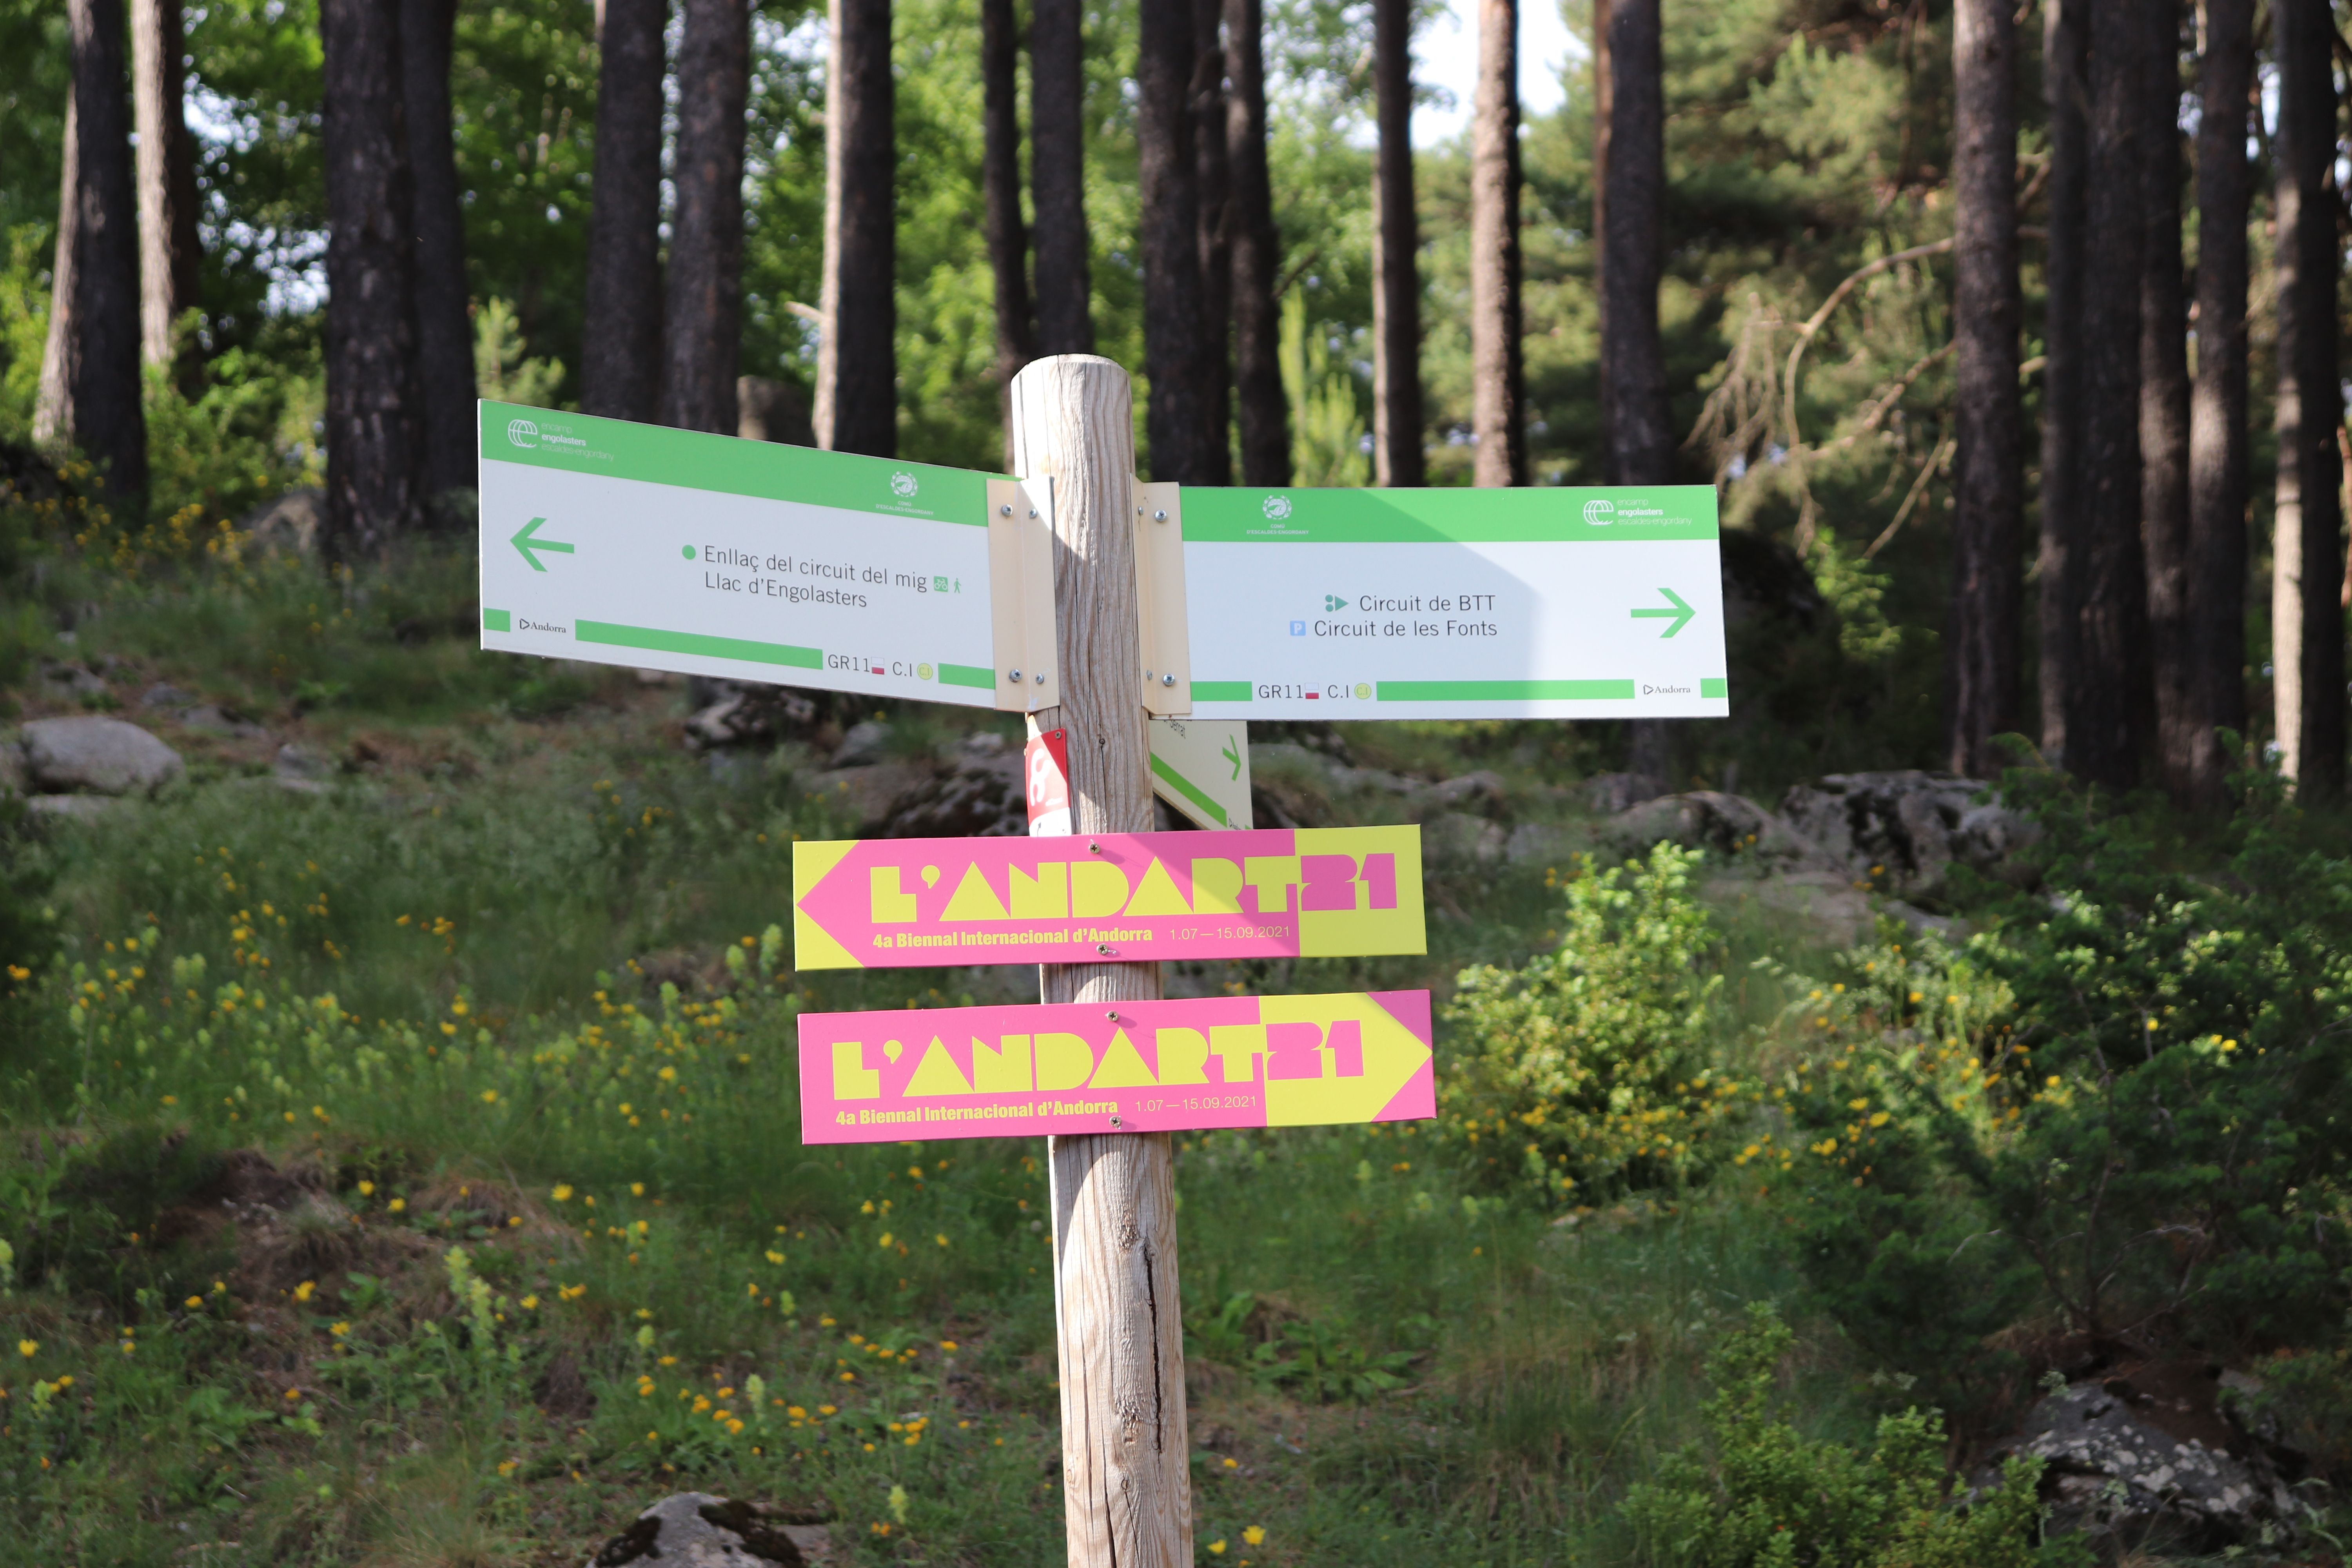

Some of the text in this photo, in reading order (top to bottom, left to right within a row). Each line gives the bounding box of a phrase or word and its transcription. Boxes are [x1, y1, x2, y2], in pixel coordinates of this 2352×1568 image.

[541, 422, 572, 433] encamp
[541, 434, 586, 446] engolasters
[541, 444, 614, 461] escaldes-engordany
[1617, 499, 1648, 508] encamp
[1618, 508, 1663, 517] engolasters
[1618, 517, 1692, 525] escaldes-engordany
[705, 545, 927, 593] Enllaç del circuit del mig
[706, 571, 741, 592] Llac
[1360, 595, 1496, 611] Circuit de BTT
[531, 622, 566, 633] Andorra
[1314, 620, 1497, 636] Circuit de les Fonts
[828, 654, 912, 677] GR11 C.I
[1258, 685, 1349, 698] GR11 C.I
[1655, 685, 1691, 693] Andorra
[873, 933, 892, 948] 4a
[897, 931, 957, 947] Biennal
[961, 927, 1069, 946] Internacional
[836, 1111, 855, 1125] 4a
[860, 1107, 921, 1124] Biennal
[925, 1102, 1033, 1121] Internacional
